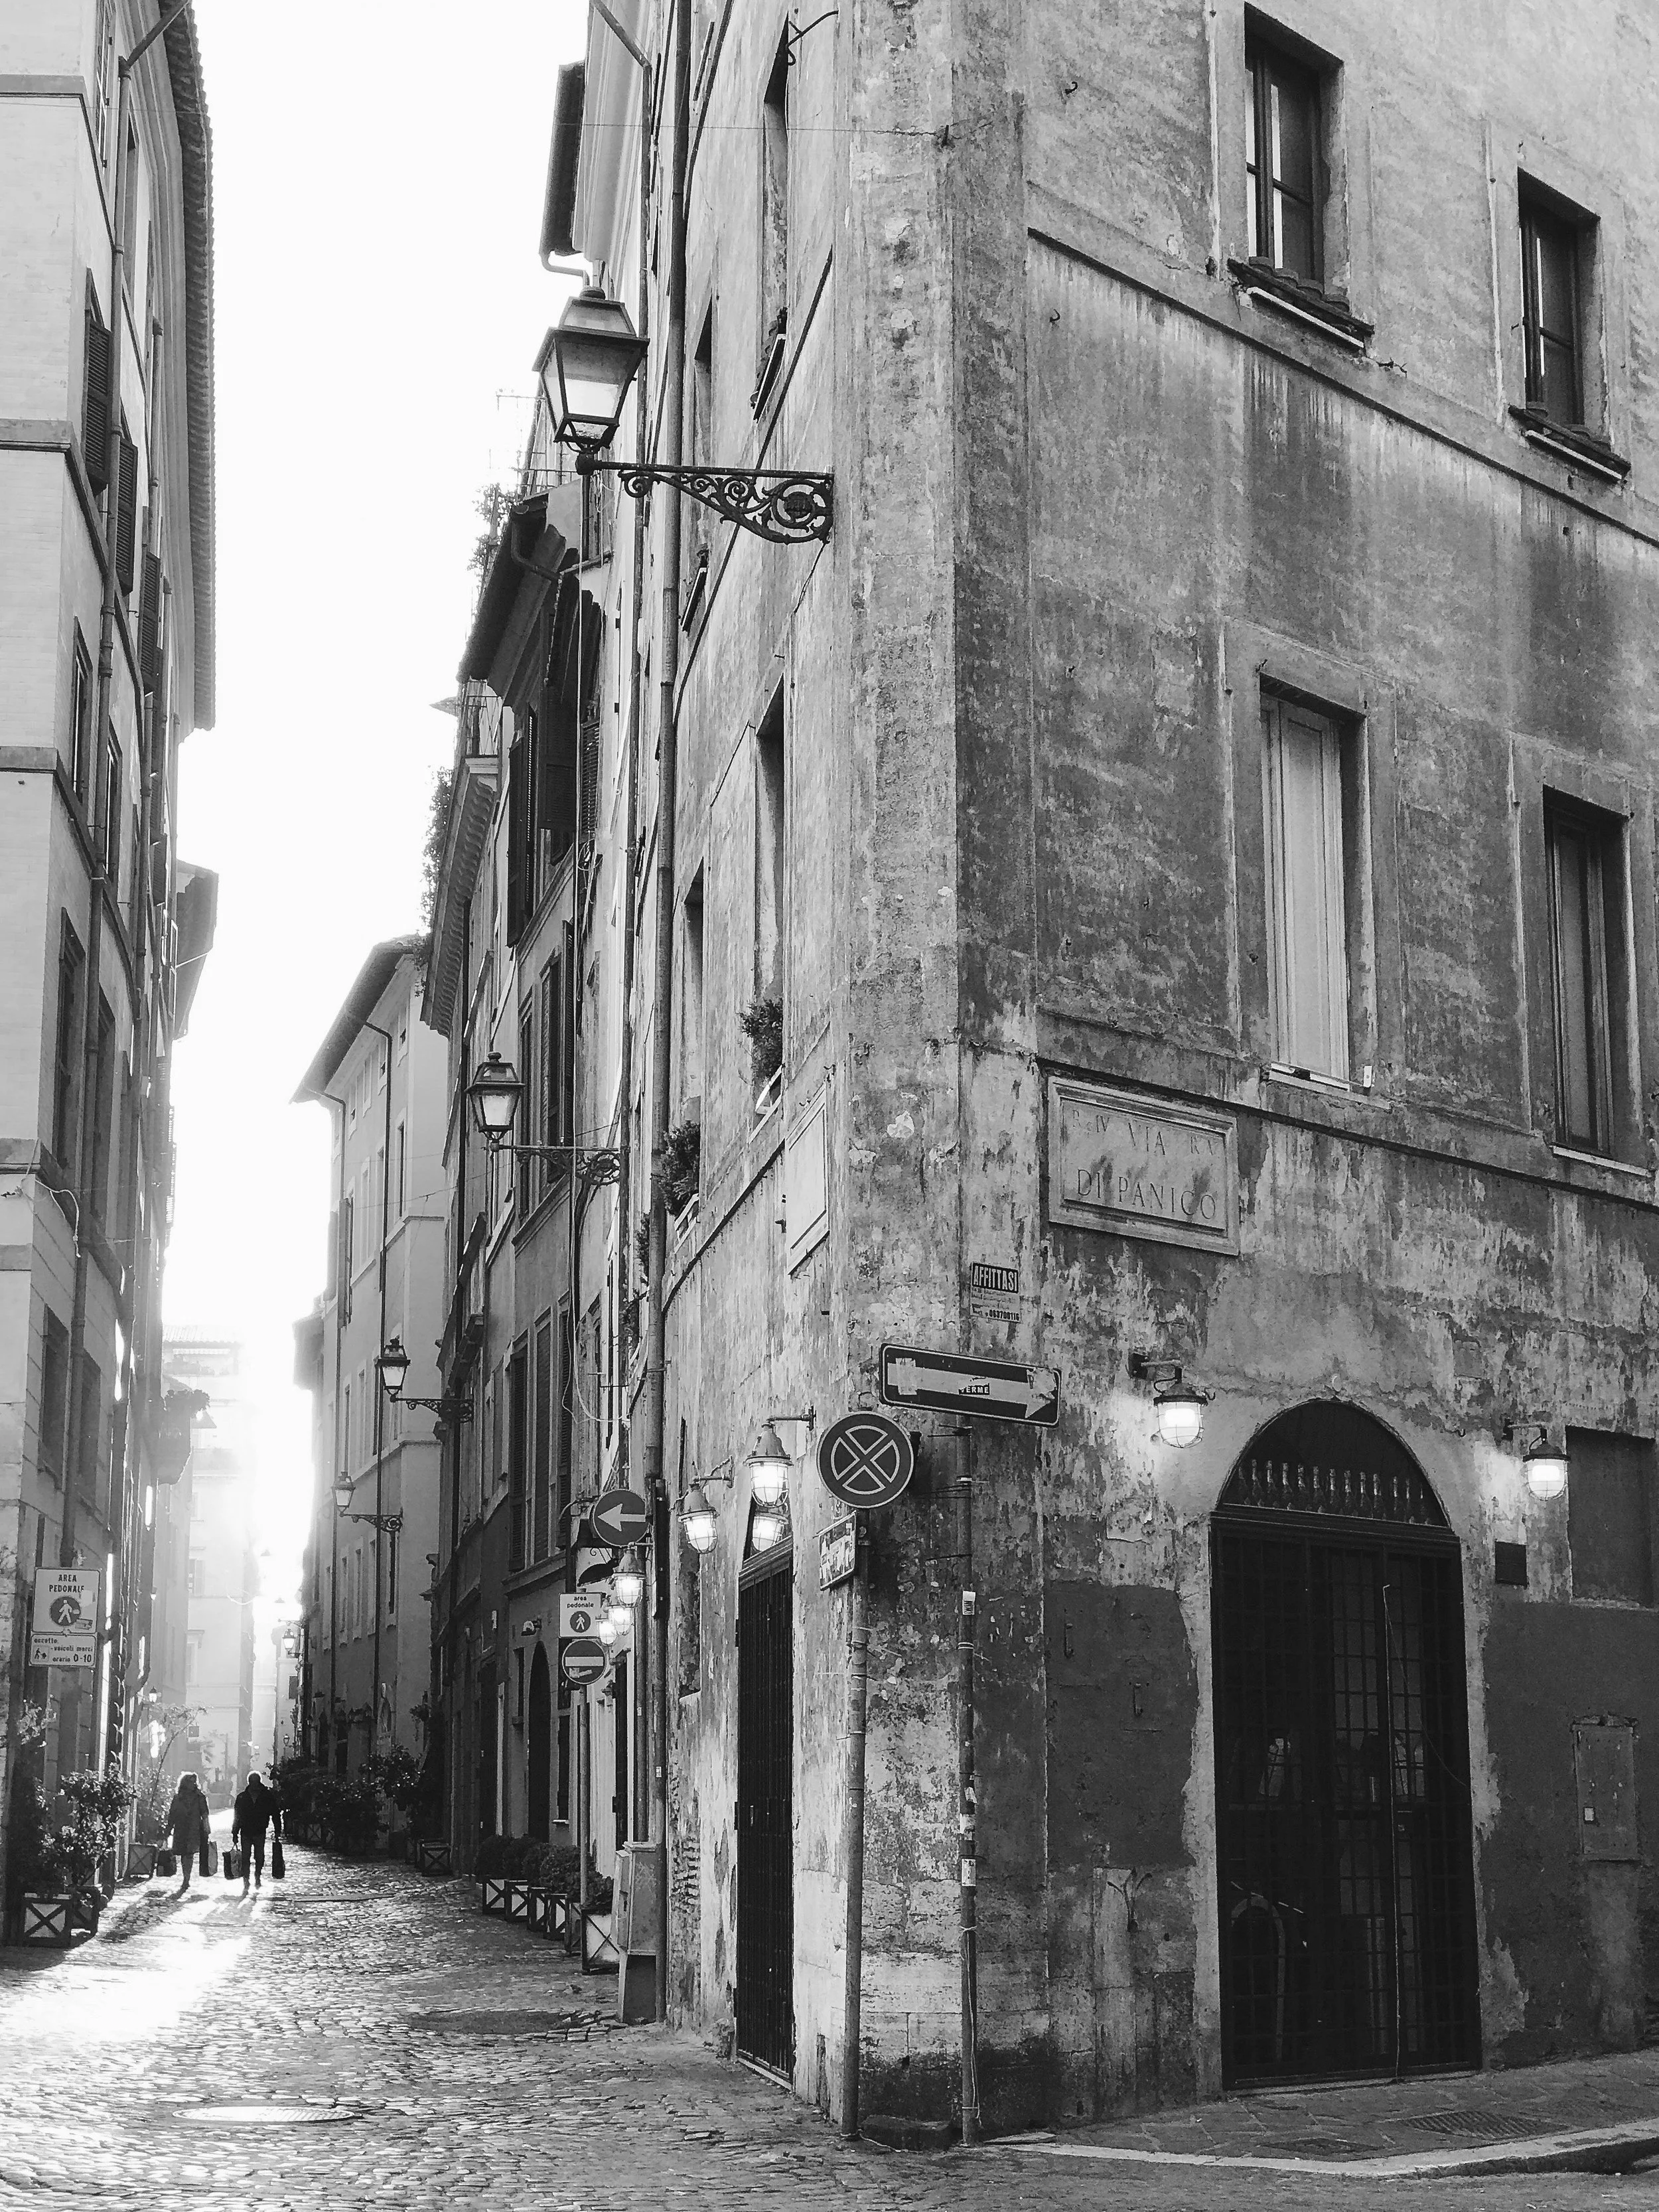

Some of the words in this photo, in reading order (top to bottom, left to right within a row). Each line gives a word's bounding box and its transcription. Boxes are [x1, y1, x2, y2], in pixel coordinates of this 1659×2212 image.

[1127, 1120, 1167, 1156] VIA
[1077, 1168, 1102, 1199] DI
[1118, 1175, 1216, 1220] PANICO
[973, 1265, 1017, 1291] AFFITTASI
[58, 1574, 78, 1582] AREA
